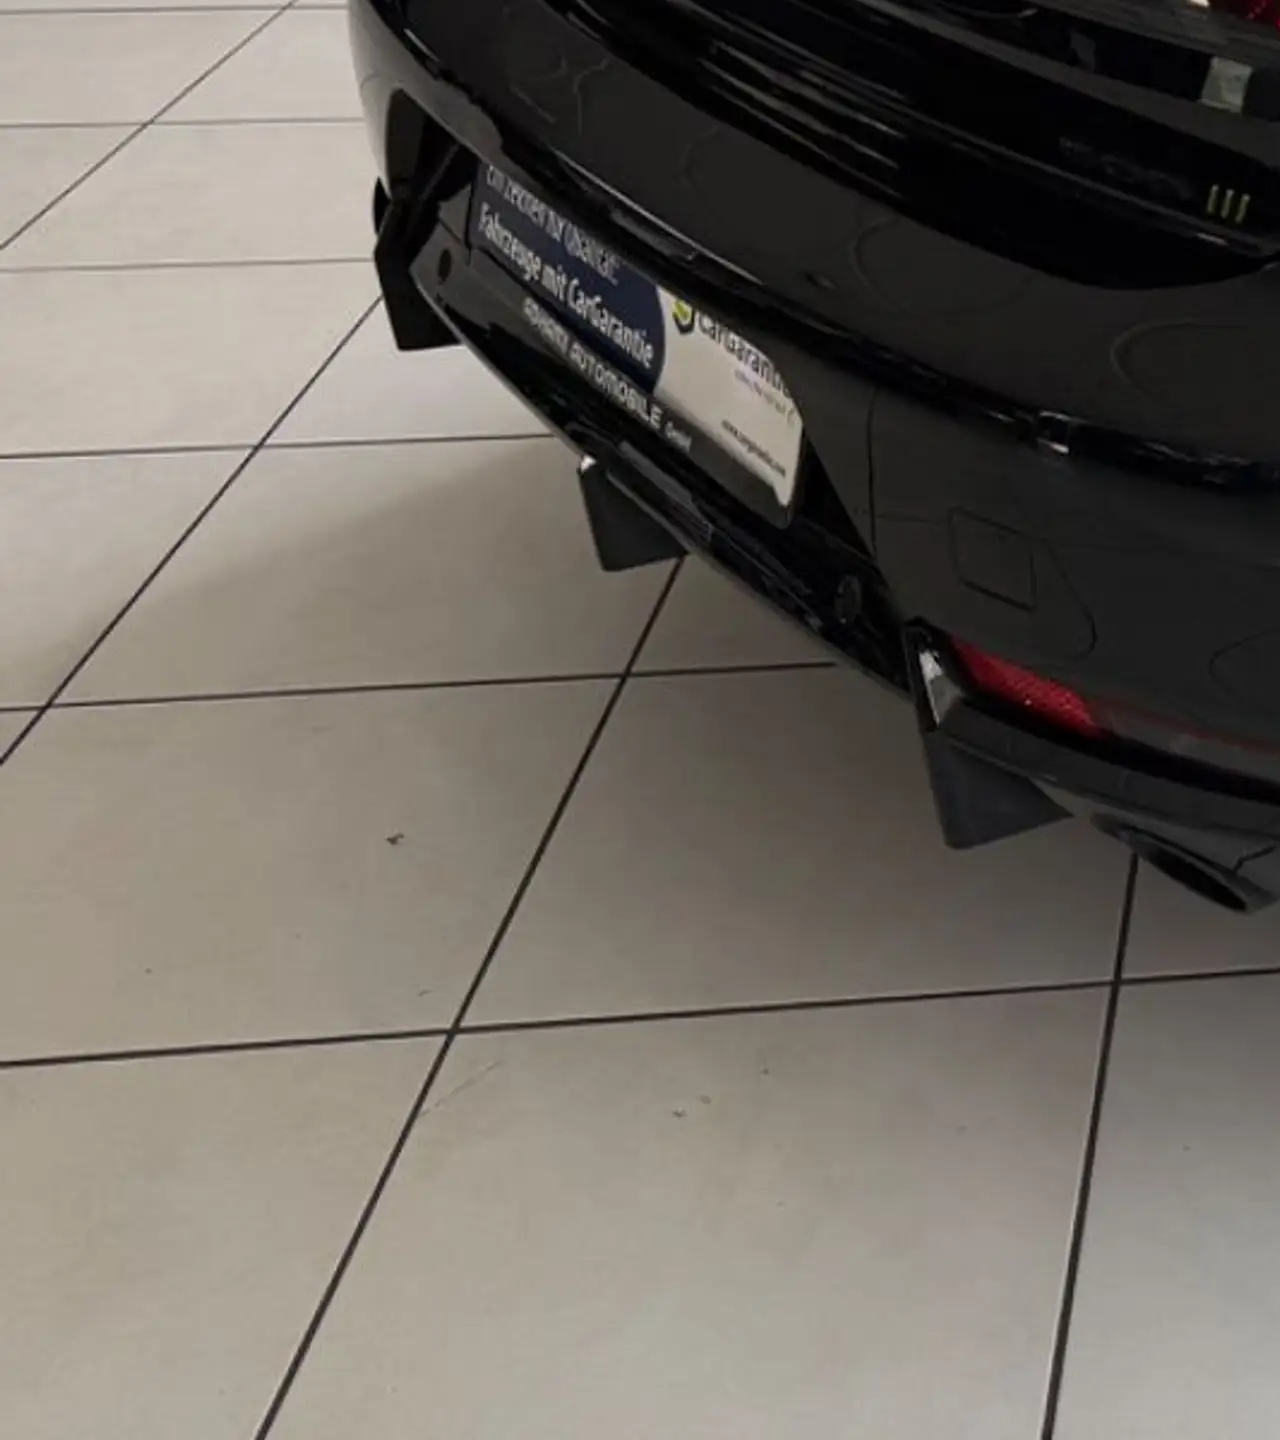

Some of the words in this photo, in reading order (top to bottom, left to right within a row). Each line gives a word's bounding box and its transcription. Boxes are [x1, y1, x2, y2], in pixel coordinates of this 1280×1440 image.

[478, 202, 542, 282] Fahrzeuge
[541, 263, 568, 302] mit
[567, 278, 654, 369] CarGarantie
[569, 341, 663, 431] AUTOMOBILE
